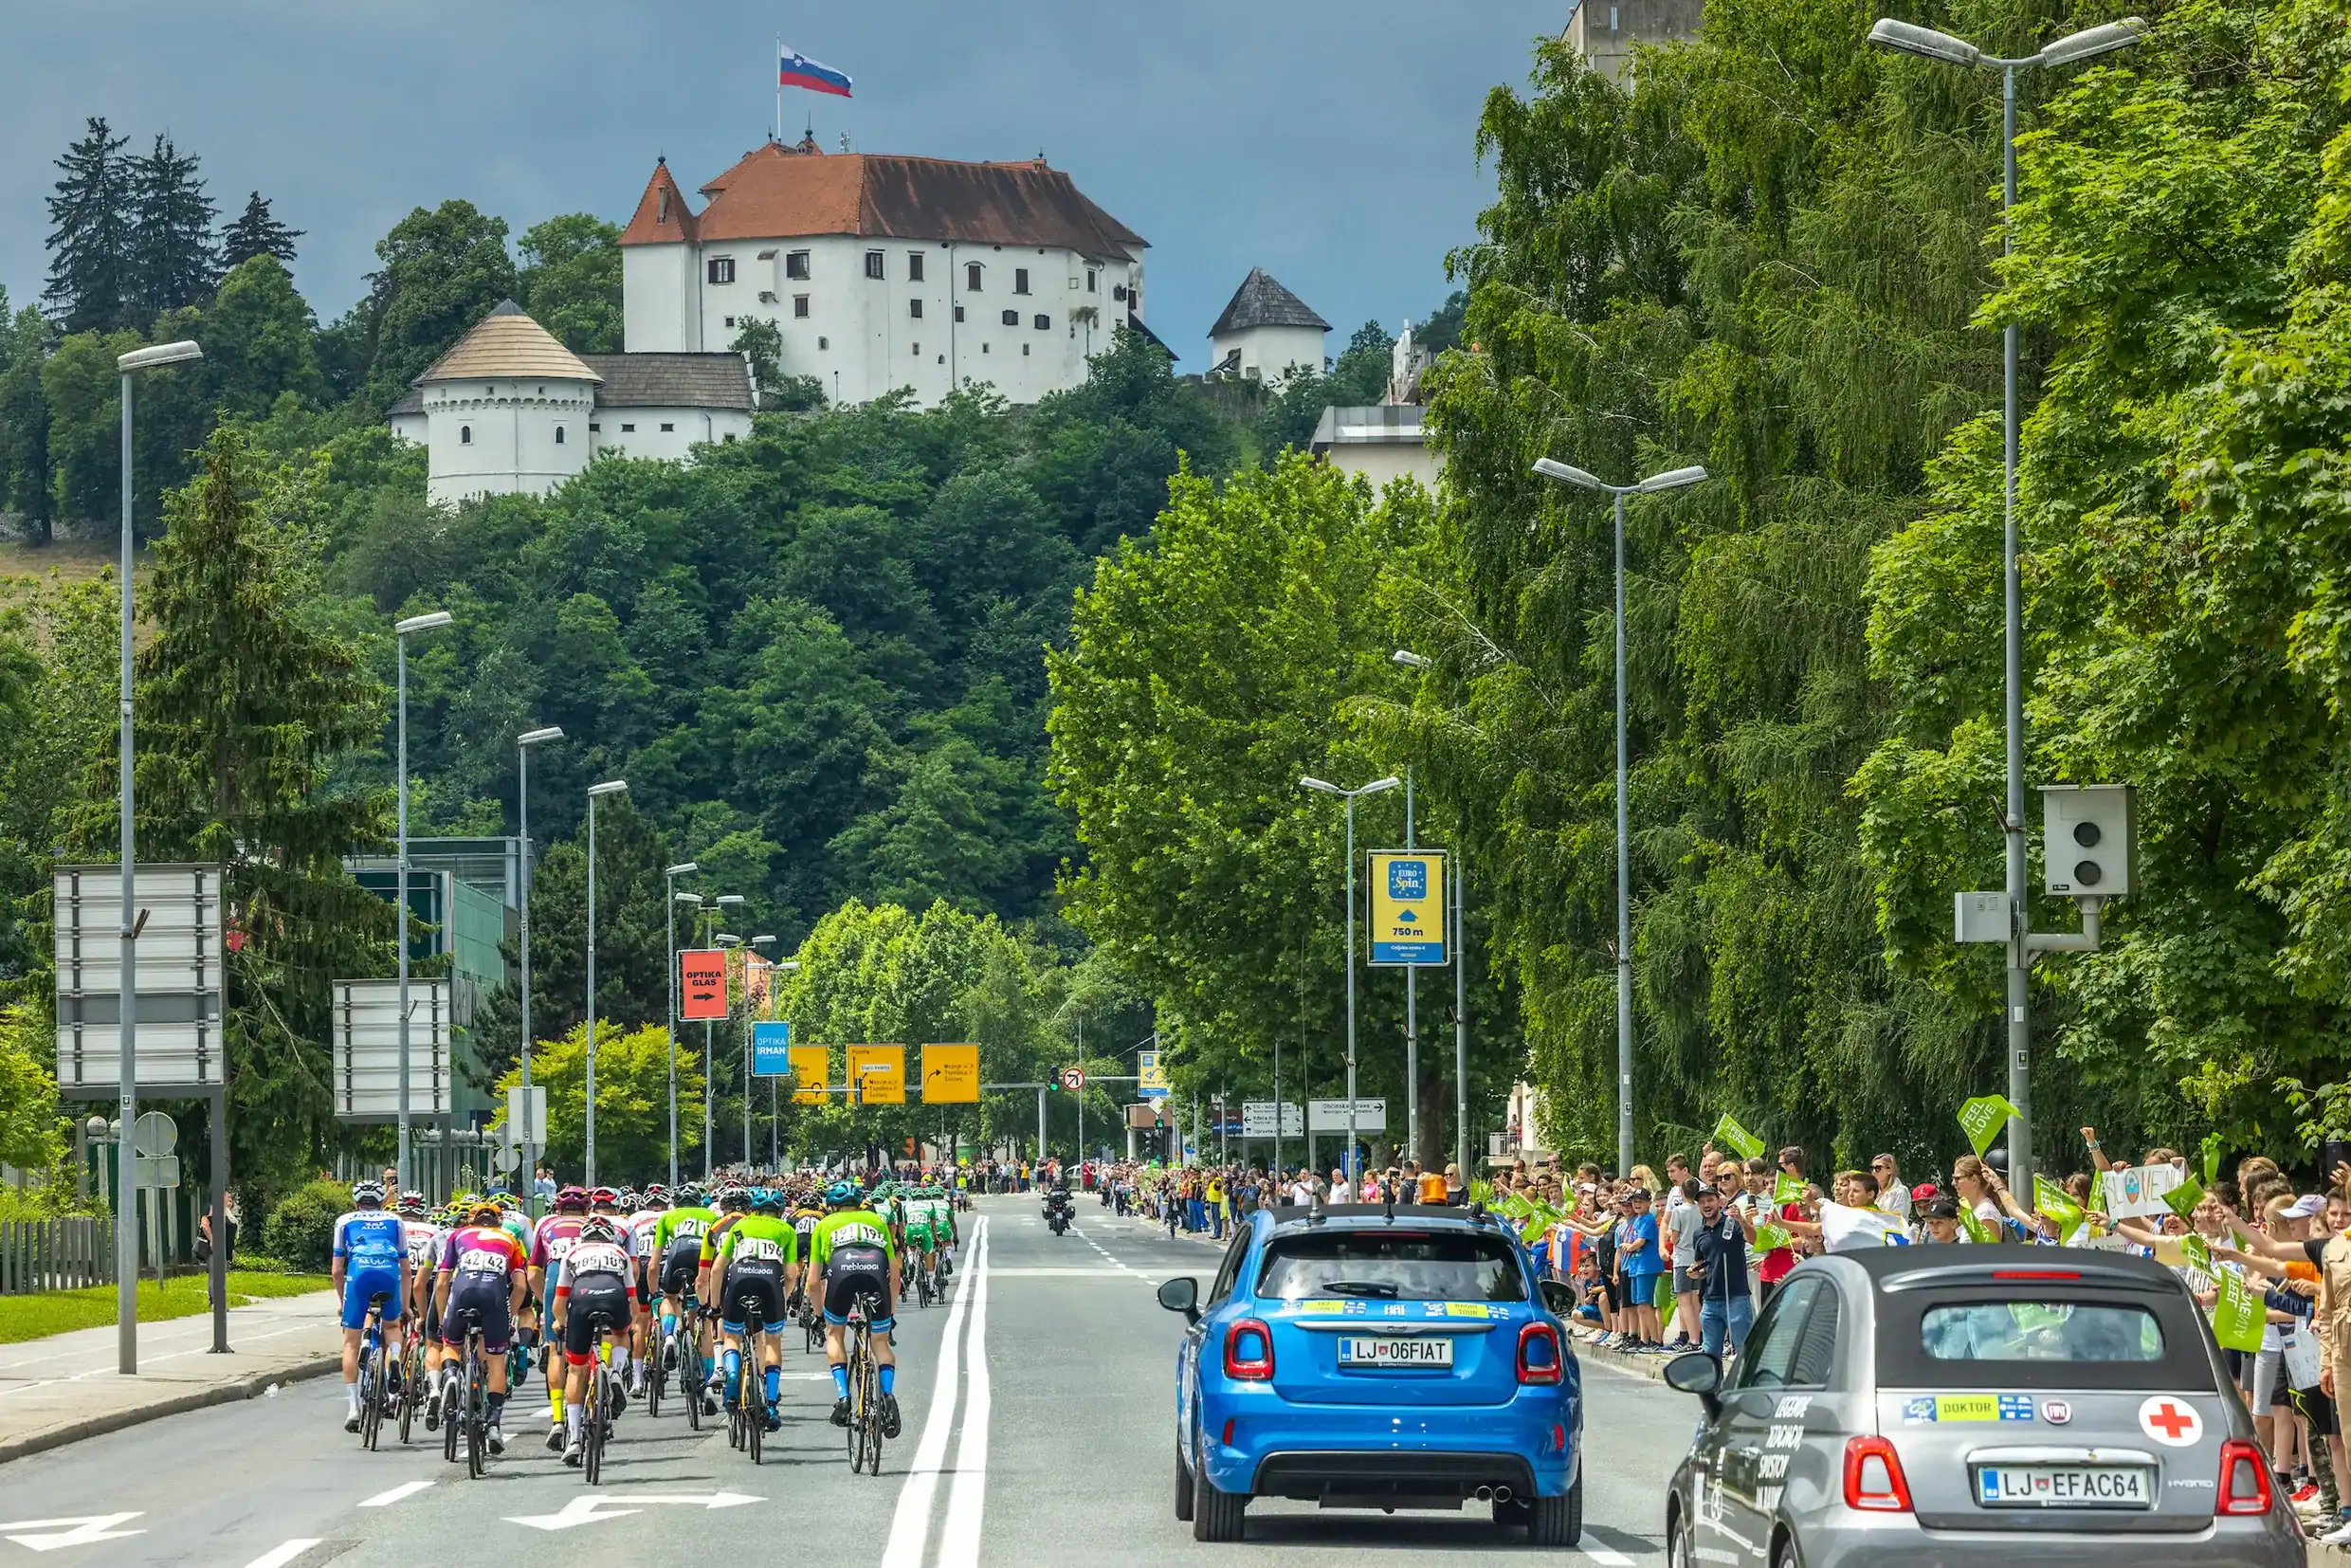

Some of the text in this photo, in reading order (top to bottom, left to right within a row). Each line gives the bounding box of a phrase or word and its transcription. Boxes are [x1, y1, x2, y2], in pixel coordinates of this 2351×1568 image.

[1395, 877, 1419, 890] Spin
[1393, 927, 1412, 937] 750
[686, 970, 722, 979] OPTIKA
[692, 978, 717, 987] GLAS
[756, 1037, 786, 1046] OPTIKA
[756, 1047, 786, 1055] IRMAN
[464, 1252, 502, 1269] 42 42
[1357, 1341, 1446, 1360] LJ 06FIAT
[1943, 1402, 1992, 1413] DOKTOR
[2003, 1472, 2140, 1498] LJ EFAC64
